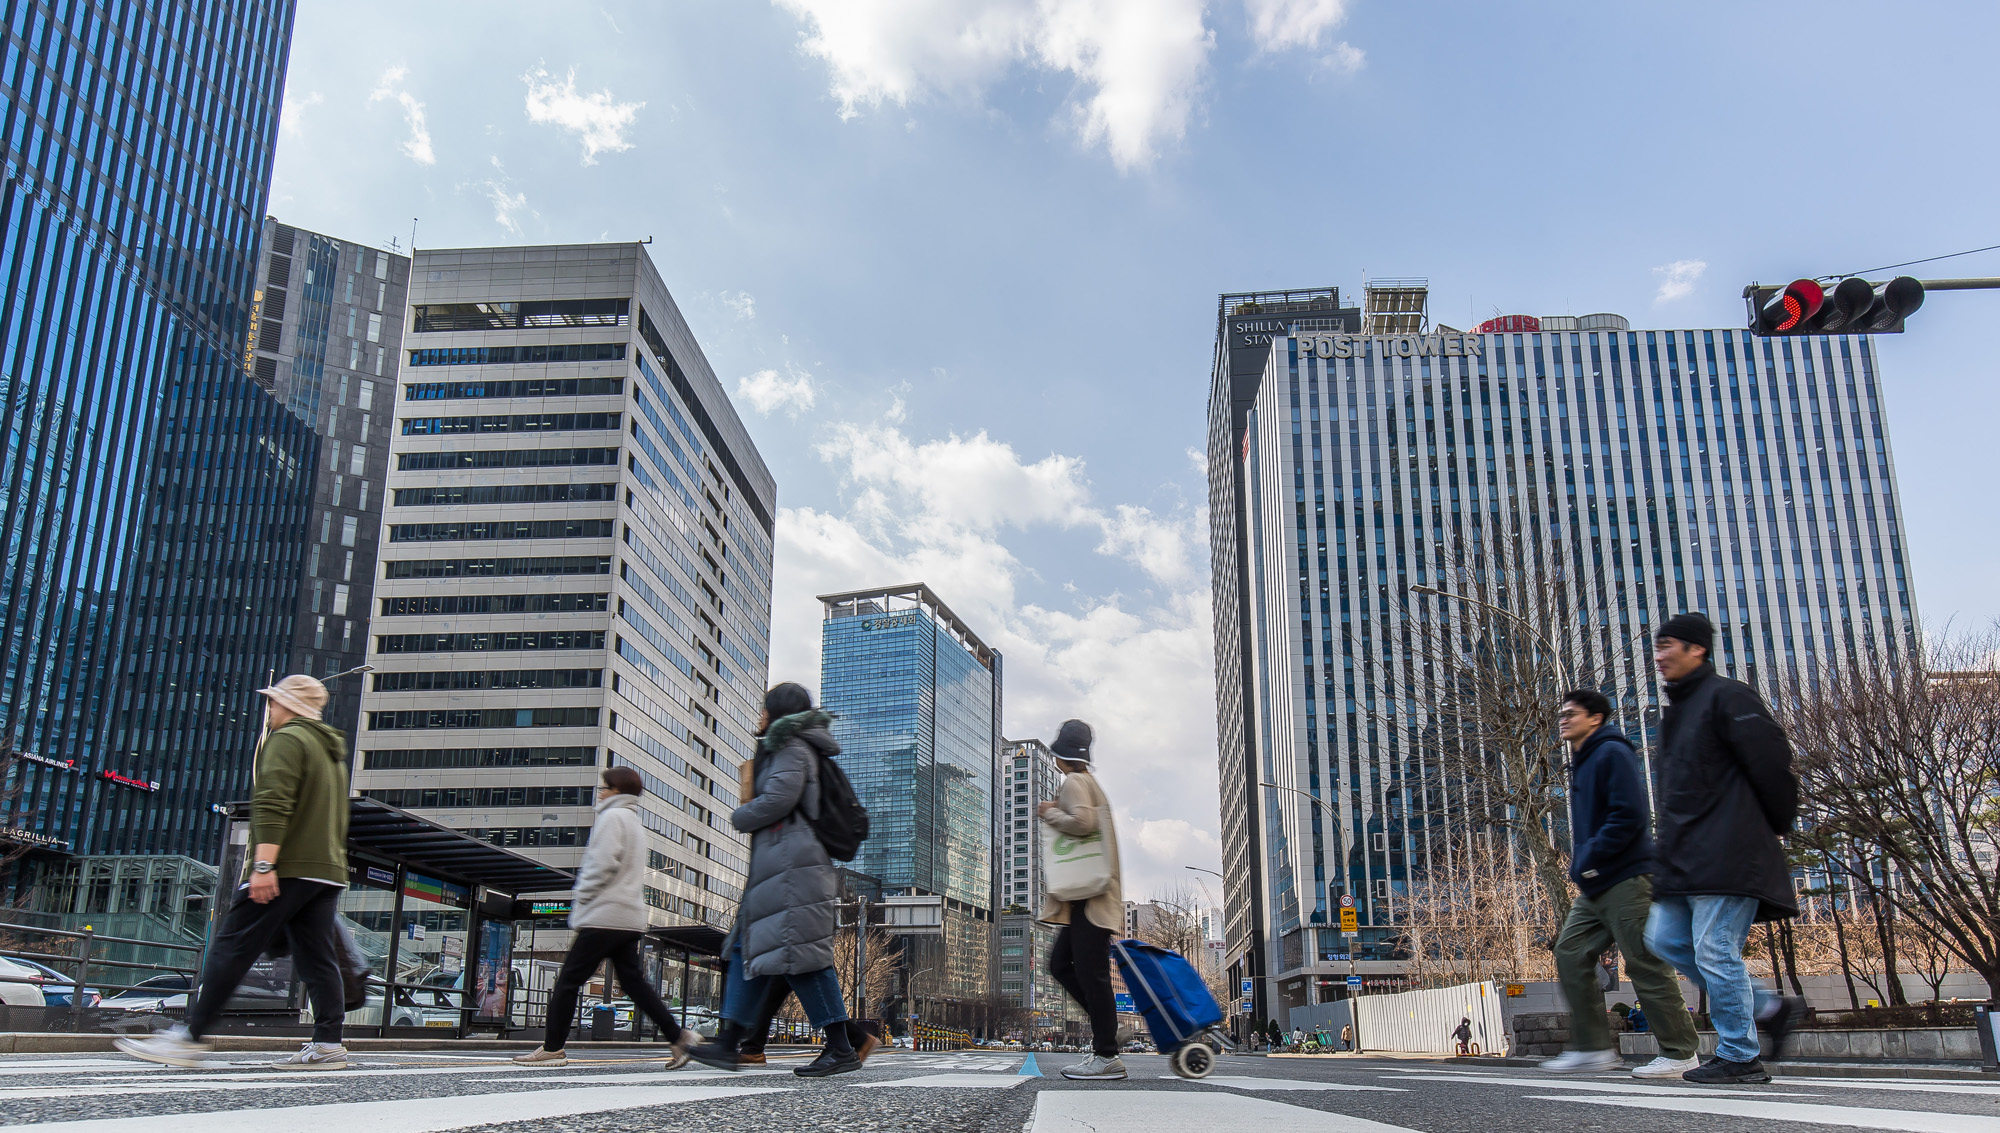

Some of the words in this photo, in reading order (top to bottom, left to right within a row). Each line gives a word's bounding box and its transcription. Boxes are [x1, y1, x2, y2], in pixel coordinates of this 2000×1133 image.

[1236, 321, 1285, 334] SHILLA
[1297, 335, 1371, 359] POST
[1377, 334, 1482, 357] TOWER
[23, 752, 44, 763] ASIANA
[44, 758, 69, 769] AIRLINES
[3, 827, 58, 845] LAGRILLIA
[1343, 897, 1351, 905] 50
